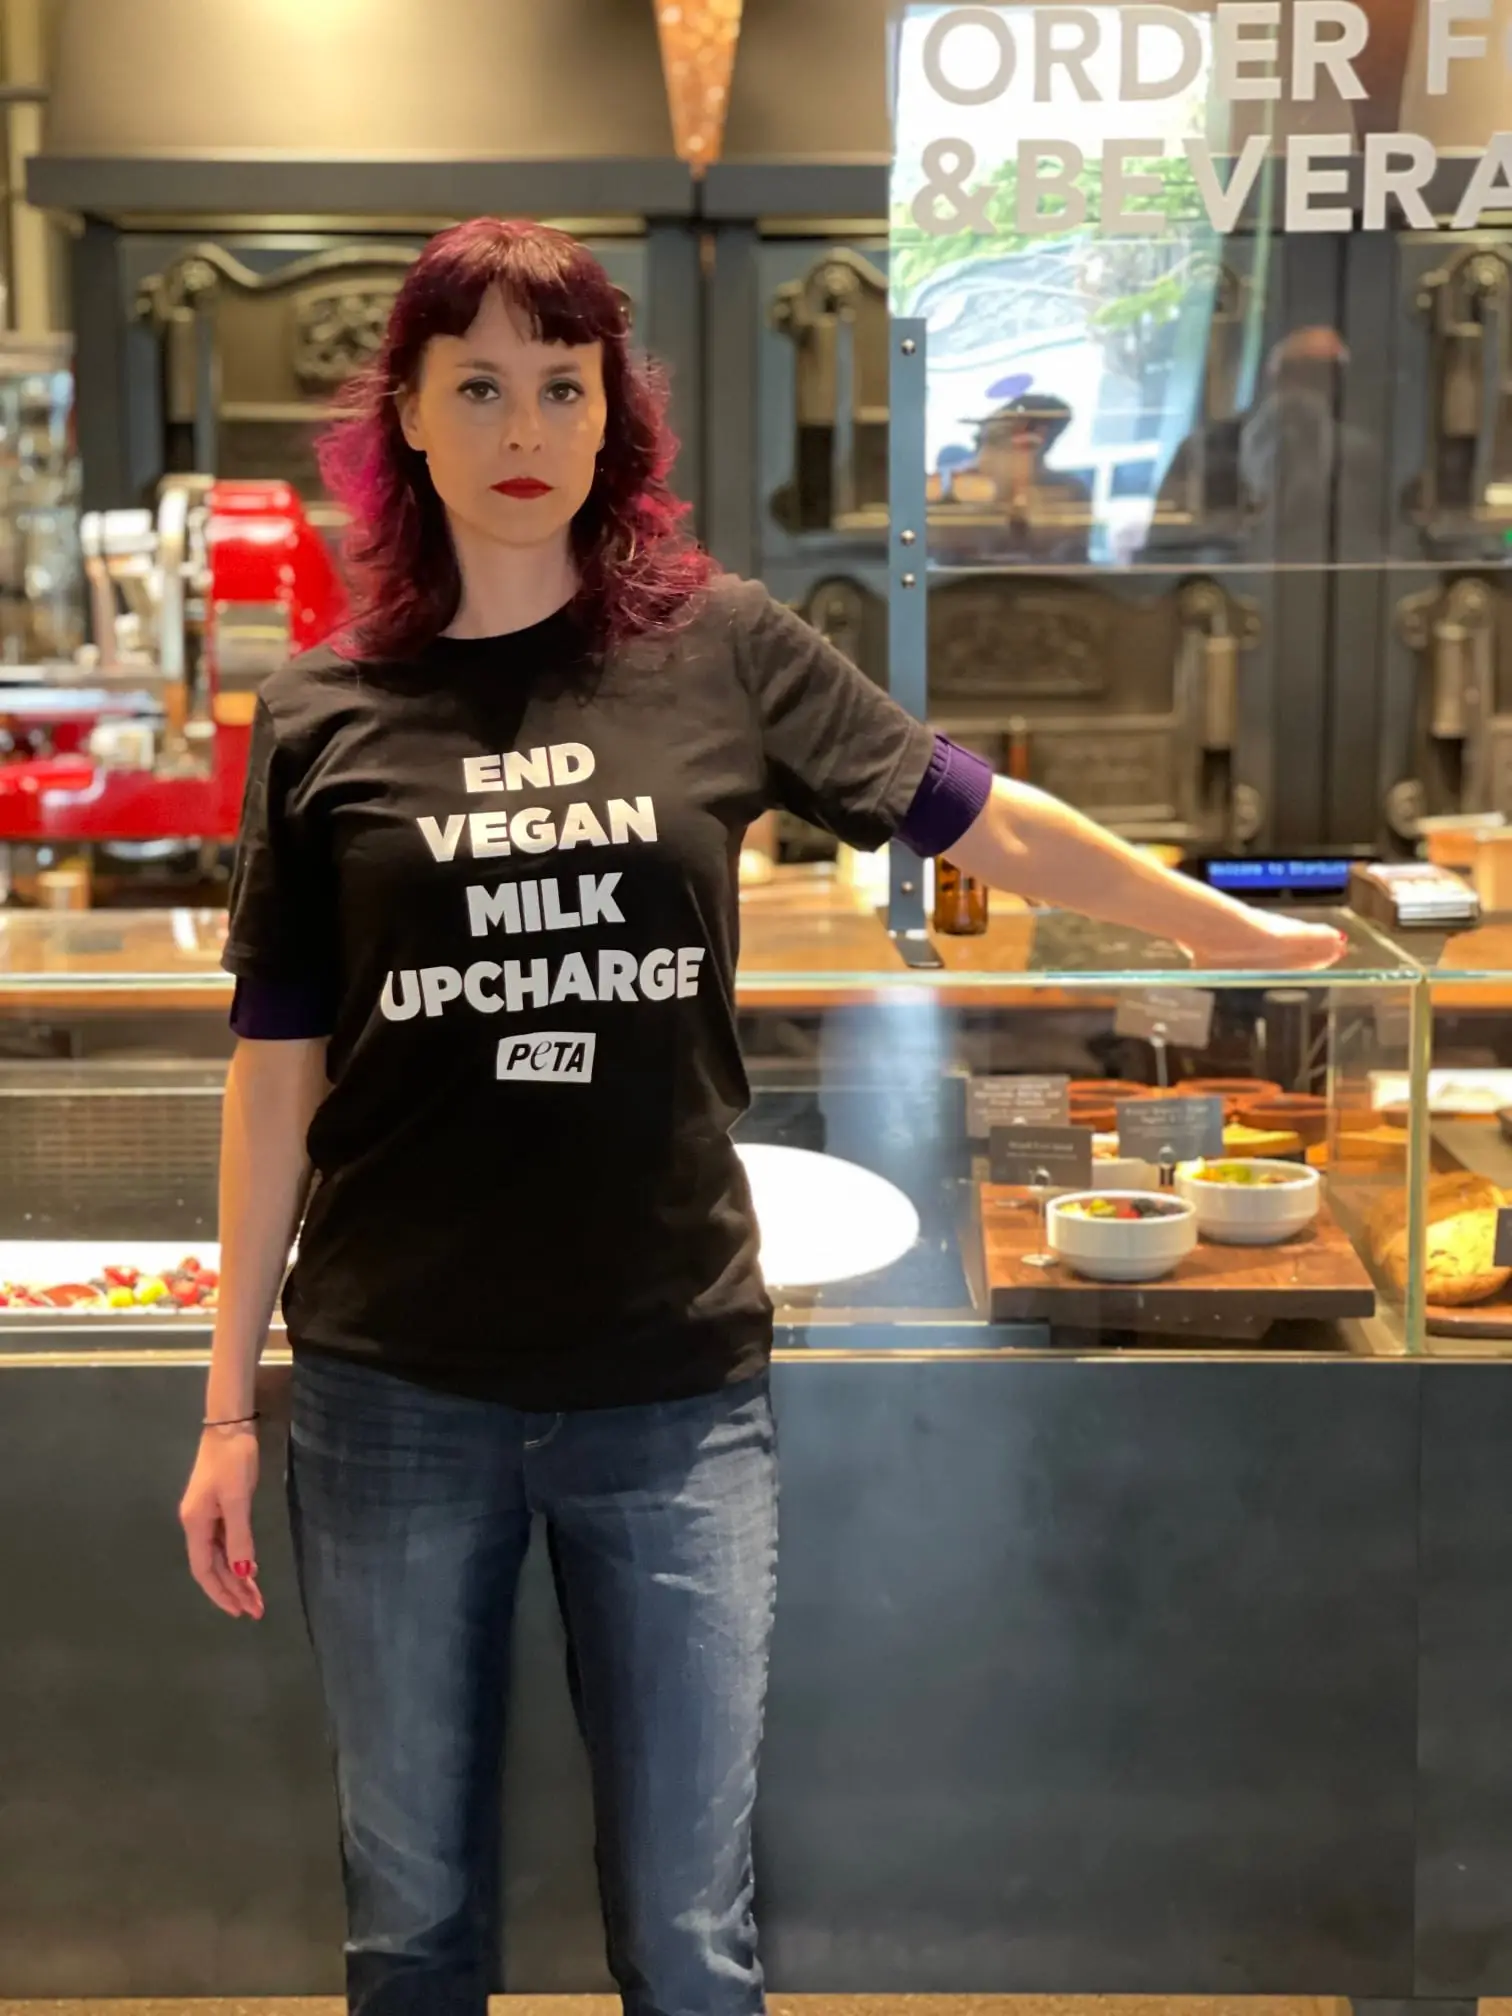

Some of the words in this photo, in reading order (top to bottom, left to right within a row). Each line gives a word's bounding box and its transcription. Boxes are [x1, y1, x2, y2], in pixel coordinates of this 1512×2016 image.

[921, 0, 1370, 106] ORDER
[1427, 0, 1512, 95] F
[463, 742, 595, 793] END
[416, 796, 658, 863] VEGAN
[466, 872, 626, 937] MILK
[380, 947, 706, 1022] UPCHARGE
